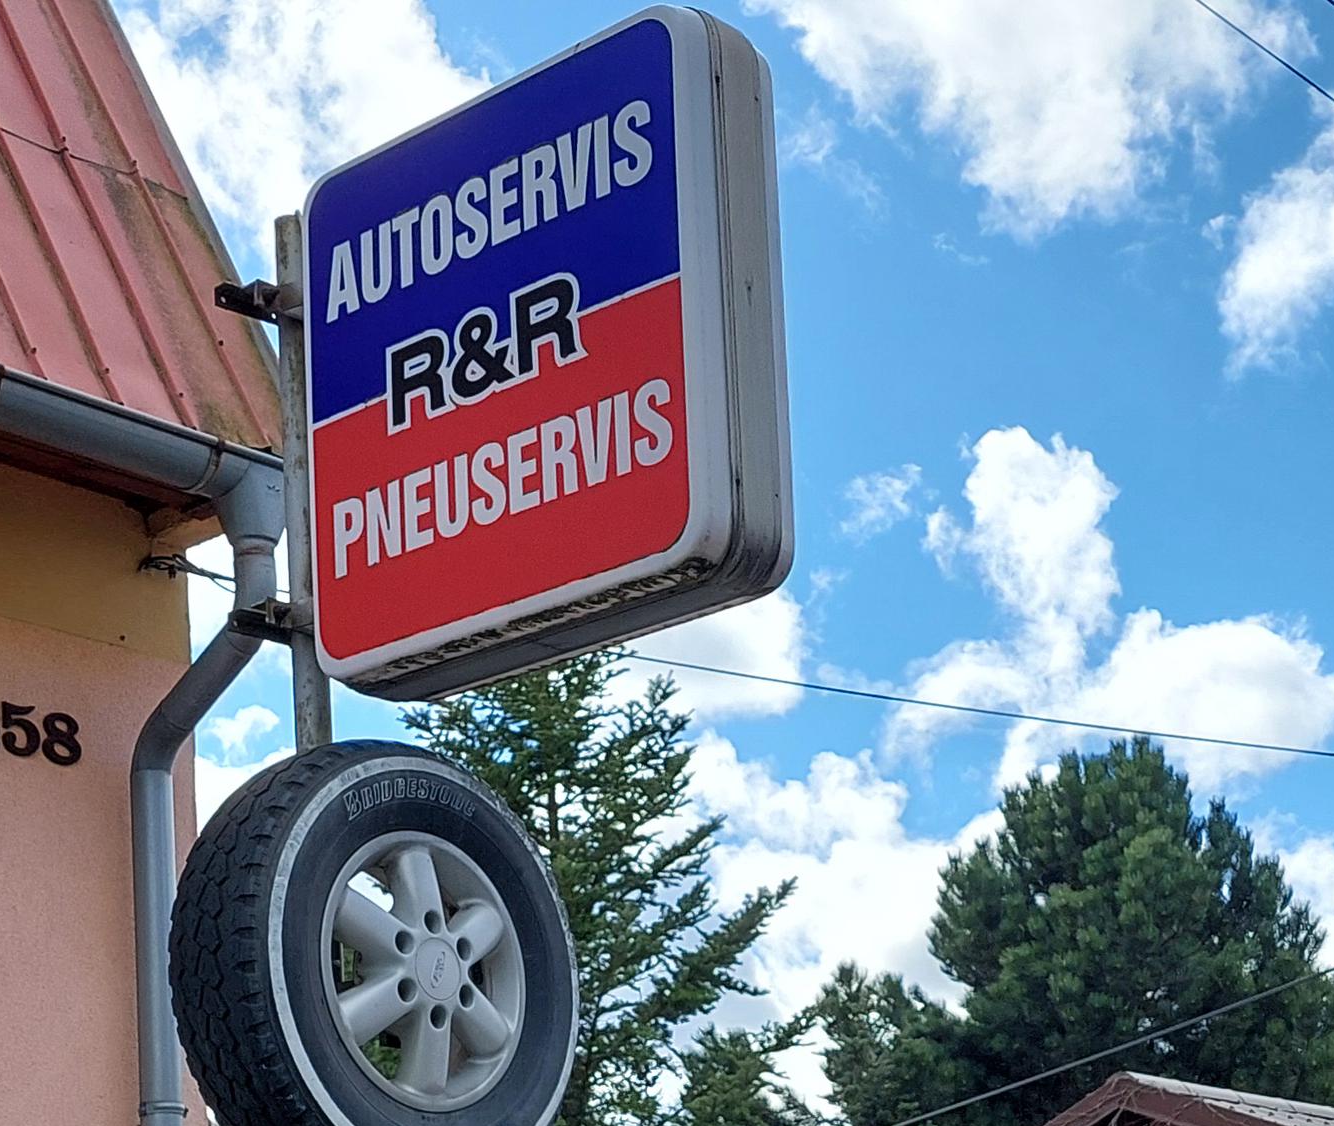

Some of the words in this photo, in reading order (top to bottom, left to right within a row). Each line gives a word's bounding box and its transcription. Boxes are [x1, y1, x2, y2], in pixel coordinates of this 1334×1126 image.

[326, 100, 653, 323] AUTOSERVIS
[388, 274, 586, 434] R&R
[333, 379, 673, 578] PNEUSERVIS
